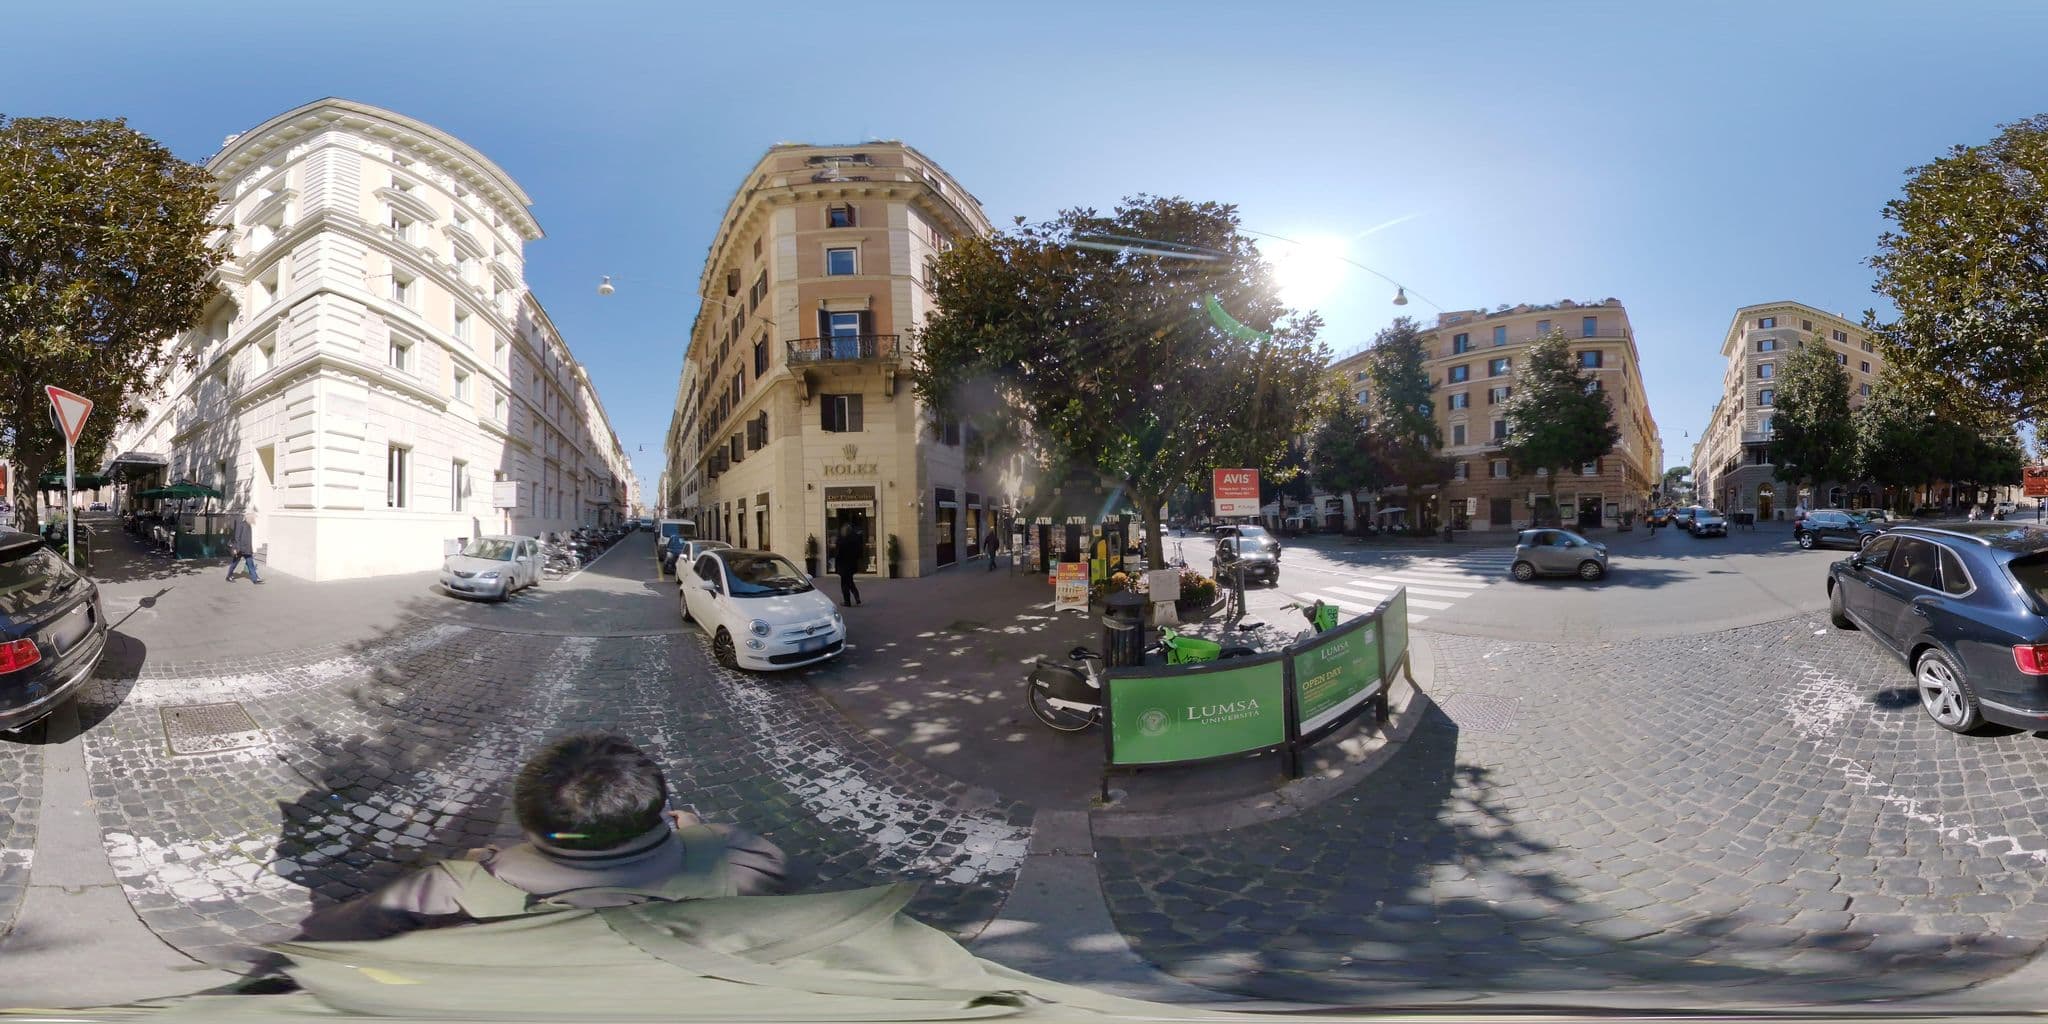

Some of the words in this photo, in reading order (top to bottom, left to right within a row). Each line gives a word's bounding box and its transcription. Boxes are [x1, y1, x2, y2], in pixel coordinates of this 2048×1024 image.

[824, 463, 878, 476] ROLEX
[1224, 473, 1250, 484] AVIS
[1035, 516, 1052, 525] ATM
[1066, 516, 1087, 525] ATM
[1102, 514, 1120, 523] ATM
[1302, 674, 1326, 690] OPEN
[1326, 665, 1343, 680] DAY
[1187, 699, 1259, 720] LUMSA
